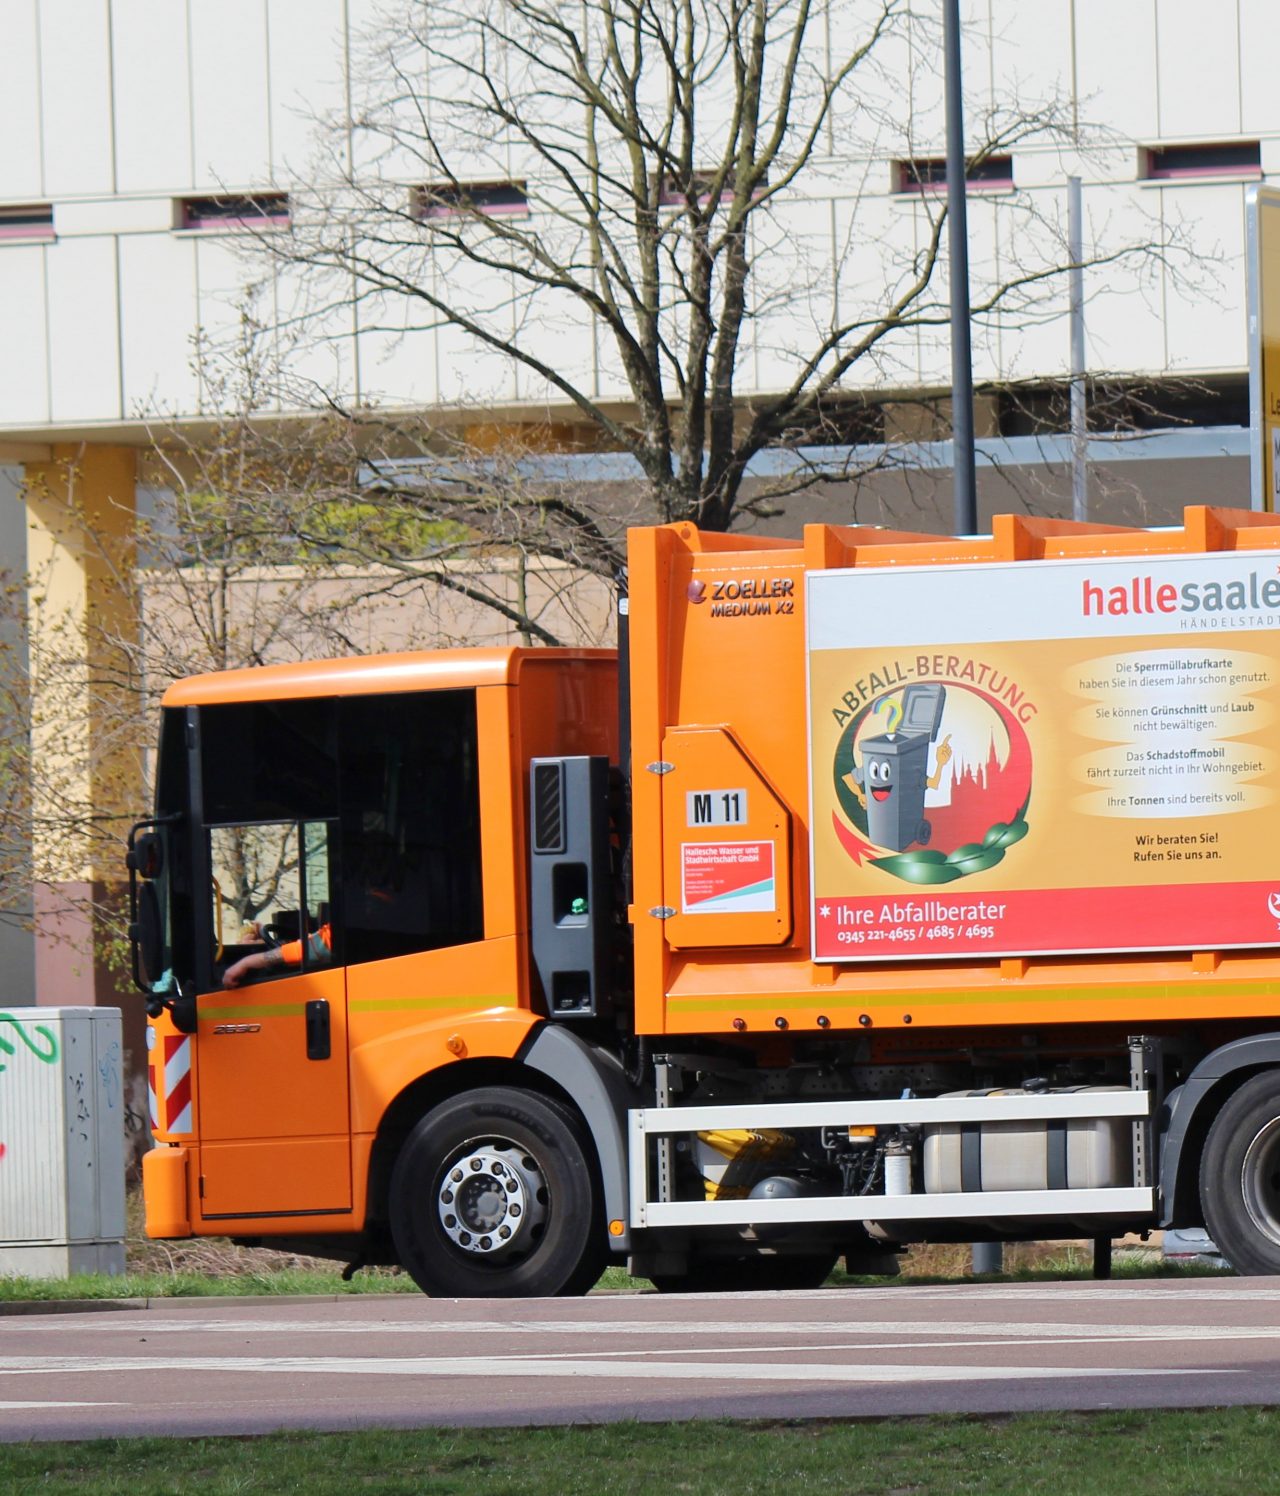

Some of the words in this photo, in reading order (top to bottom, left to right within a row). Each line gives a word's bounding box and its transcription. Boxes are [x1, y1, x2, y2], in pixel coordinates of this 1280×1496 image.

[711, 578, 794, 601] ZOELLER
[711, 602, 771, 618] MEDIUM
[775, 601, 794, 615] X2
[1116, 663, 1132, 673] Die
[1134, 659, 1233, 675] Sperrmüllabrufkarte
[1079, 679, 1109, 689] haben
[1112, 678, 1126, 688] Sie
[1128, 678, 1137, 687] in
[1140, 676, 1174, 687] diesem
[1176, 675, 1196, 685] Jahr
[1199, 674, 1227, 684] schon
[1229, 672, 1270, 685] genutzt.
[831, 654, 1038, 728] ABFALL-BERATUNG
[1096, 709, 1110, 718] Sie
[1113, 706, 1148, 718] können
[1151, 704, 1208, 716] Grünschnitt
[1210, 703, 1229, 713] und
[1231, 702, 1255, 712] Laub
[1133, 721, 1157, 731] nicht
[1160, 719, 1217, 732] bewältigen.
[1126, 752, 1144, 761] Das
[1146, 748, 1225, 760] Schadstoffmobil
[1087, 767, 1111, 778] fährt
[1113, 766, 1146, 776] zurzeit
[1148, 765, 1172, 775] nicht
[1175, 764, 1184, 774] in
[1187, 764, 1200, 774] Ihr
[1202, 761, 1265, 775] Wohngebiet.
[1107, 797, 1127, 806] Ihre
[1128, 796, 1165, 806] Tonnen
[1167, 794, 1187, 804] sind
[1190, 793, 1223, 804] bereits
[1225, 791, 1245, 802] voll.
[694, 794, 712, 823] M
[722, 793, 739, 822] 11
[1136, 835, 1154, 846] Wir
[1157, 834, 1197, 845] beraten
[1199, 833, 1219, 844] Sie!
[685, 847, 718, 856] Hallesche
[685, 855, 737, 864] Stadtwirtschaft
[738, 854, 759, 862] GmbH
[1133, 852, 1164, 862] Rufen
[1167, 850, 1182, 861] Sie
[1185, 852, 1203, 860] uns
[1206, 850, 1222, 859] an.
[837, 905, 874, 925] Ihre
[879, 901, 1006, 924] Abfallberater
[837, 931, 865, 944] 0345
[867, 927, 916, 941] 221-4655
[918, 927, 924, 938] /
[926, 925, 955, 940] 4685
[957, 925, 963, 936] /
[965, 924, 994, 938] 4695
